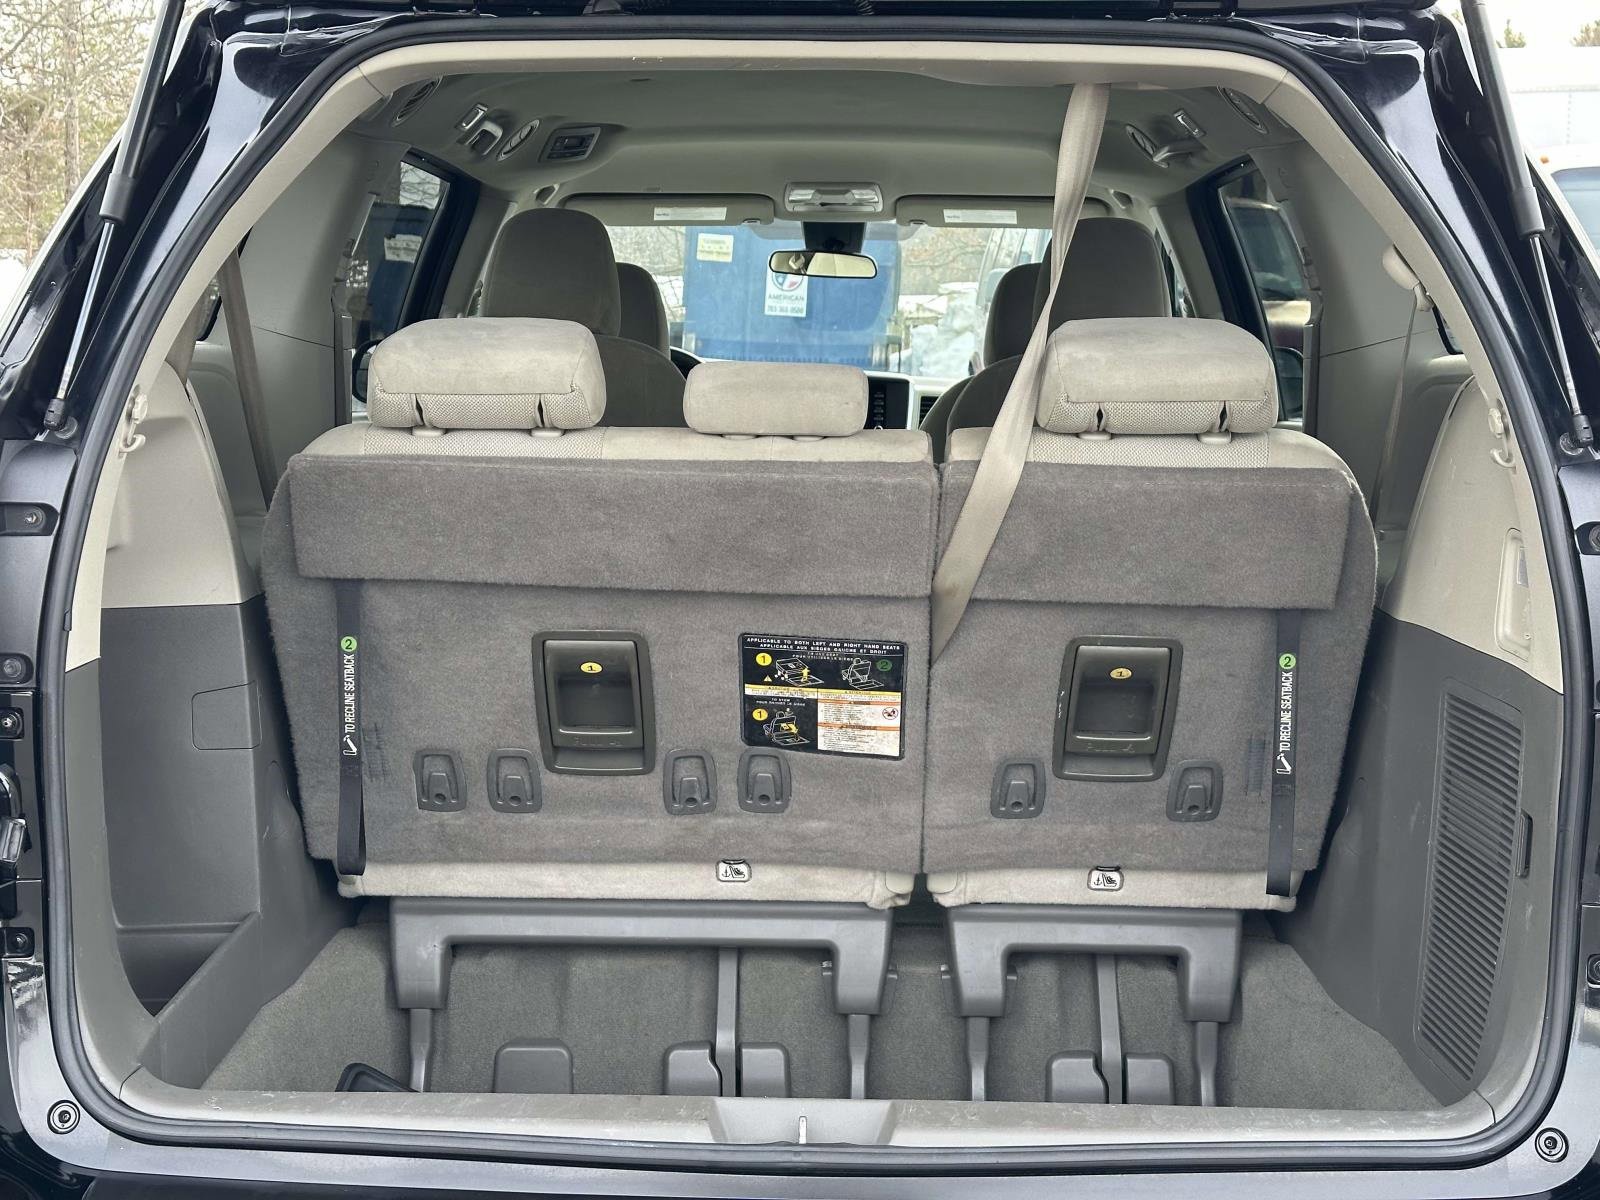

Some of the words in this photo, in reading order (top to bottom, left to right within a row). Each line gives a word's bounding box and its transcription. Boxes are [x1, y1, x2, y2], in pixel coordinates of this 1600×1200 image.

[768, 293, 805, 301] AMERICAN
[344, 638, 353, 650] 2
[1283, 656, 1292, 668] 2
[343, 654, 355, 691] SEATBACK
[1281, 671, 1293, 709] SEATBACK
[344, 692, 356, 724] RECLINE
[344, 724, 356, 733] TO
[1280, 710, 1292, 742] RECLINE
[1279, 743, 1291, 752] TO
